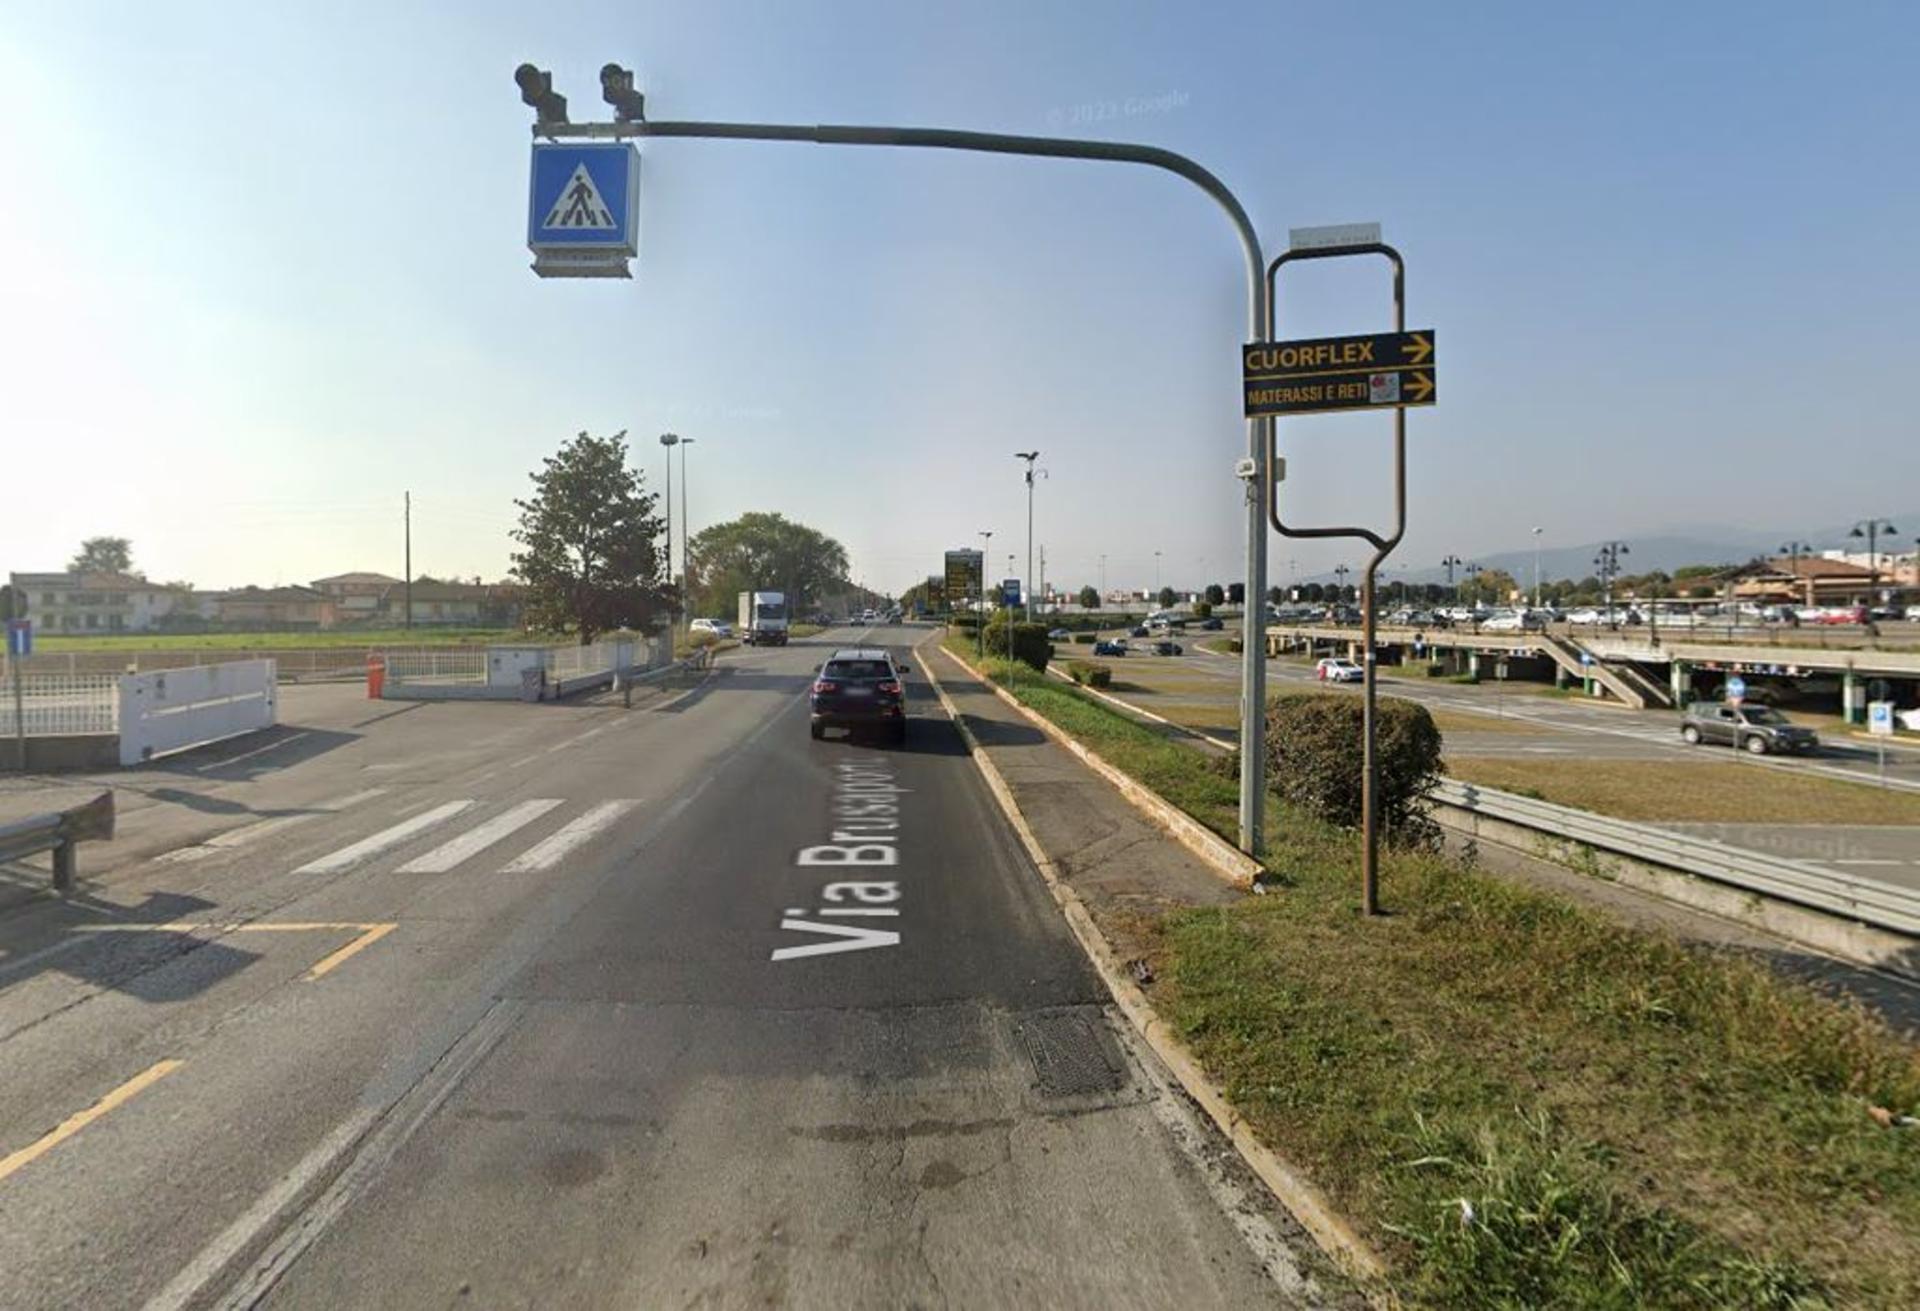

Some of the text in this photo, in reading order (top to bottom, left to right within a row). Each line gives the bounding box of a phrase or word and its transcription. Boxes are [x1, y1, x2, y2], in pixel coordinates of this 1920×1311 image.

[1246, 341, 1374, 369] CUORFLEX
[1249, 385, 1322, 406] MATERASSI
[1327, 385, 1335, 399] E
[1338, 383, 1367, 399] RETI
